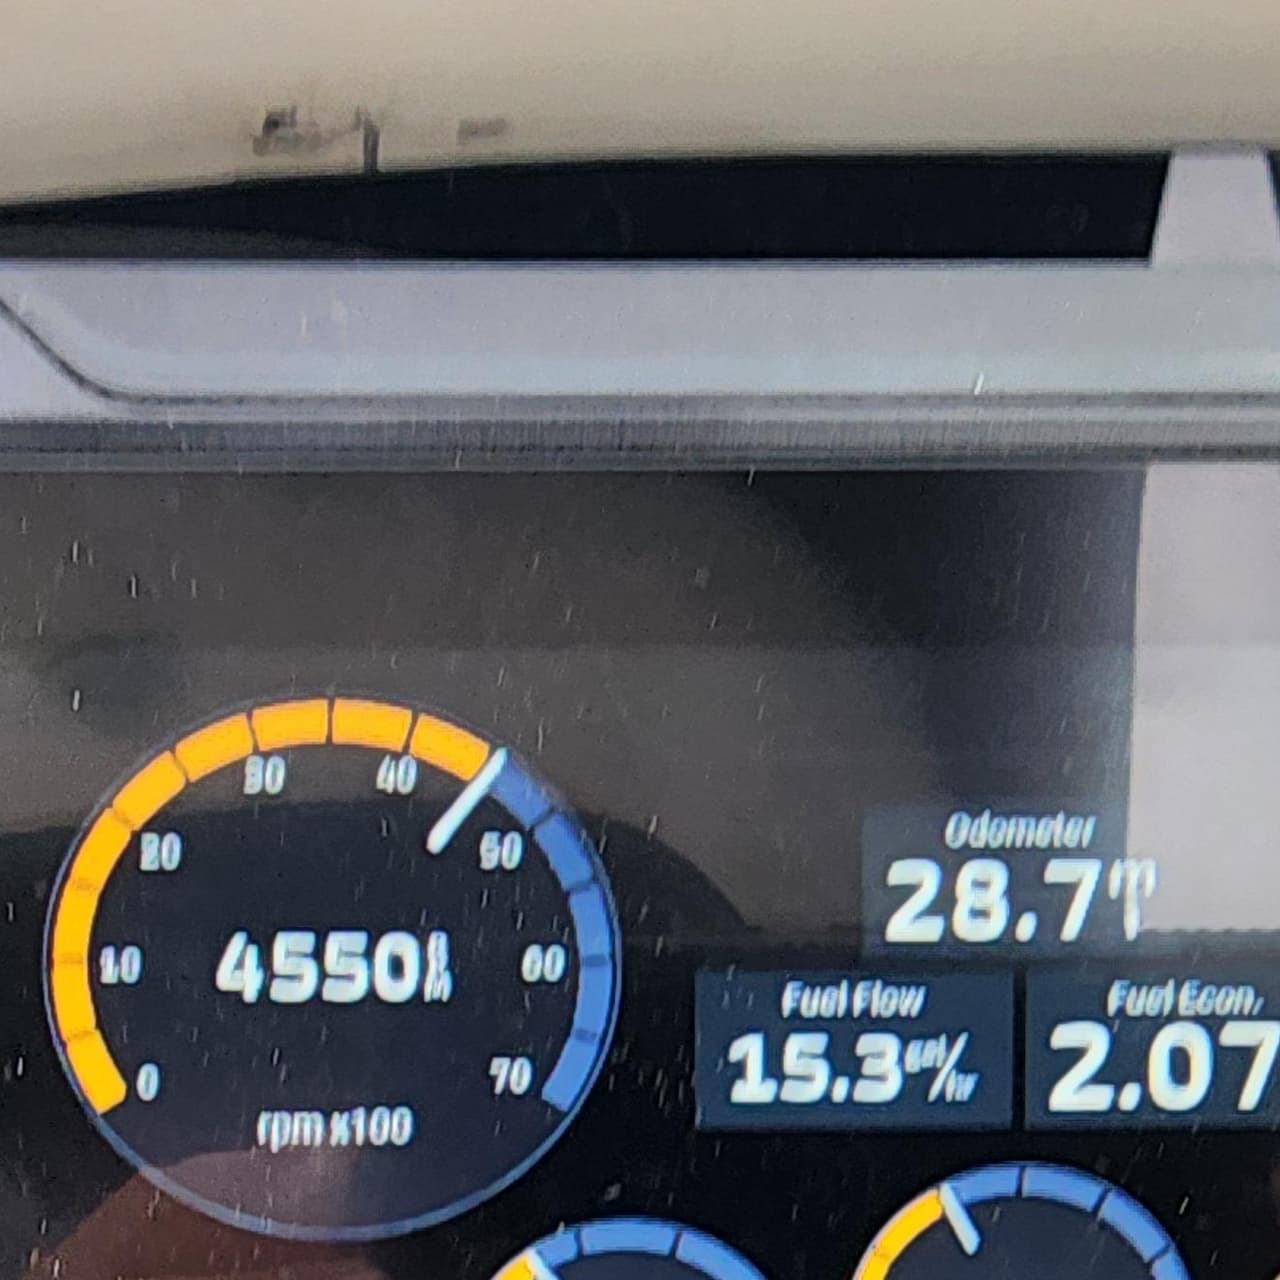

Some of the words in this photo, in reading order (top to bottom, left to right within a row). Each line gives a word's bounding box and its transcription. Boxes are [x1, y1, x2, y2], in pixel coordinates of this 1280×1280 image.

[243, 756, 286, 794] 30
[376, 756, 418, 794] 40
[944, 808, 1097, 849] Odometer
[140, 832, 183, 871] 20
[479, 831, 522, 869] 50
[884, 858, 1102, 943] 28.7
[100, 946, 142, 983] 10
[216, 931, 422, 1003] 4550
[521, 945, 566, 982] 60
[782, 980, 846, 1018] Fuel
[854, 980, 926, 1017] Flow
[1107, 977, 1175, 1017] Fuel
[1178, 979, 1264, 1016] Econ.
[136, 1064, 159, 1100] 0
[489, 1057, 532, 1094] 70
[728, 1033, 903, 1103] 15.3
[257, 1111, 323, 1153] rpm
[330, 1106, 413, 1146] x100
